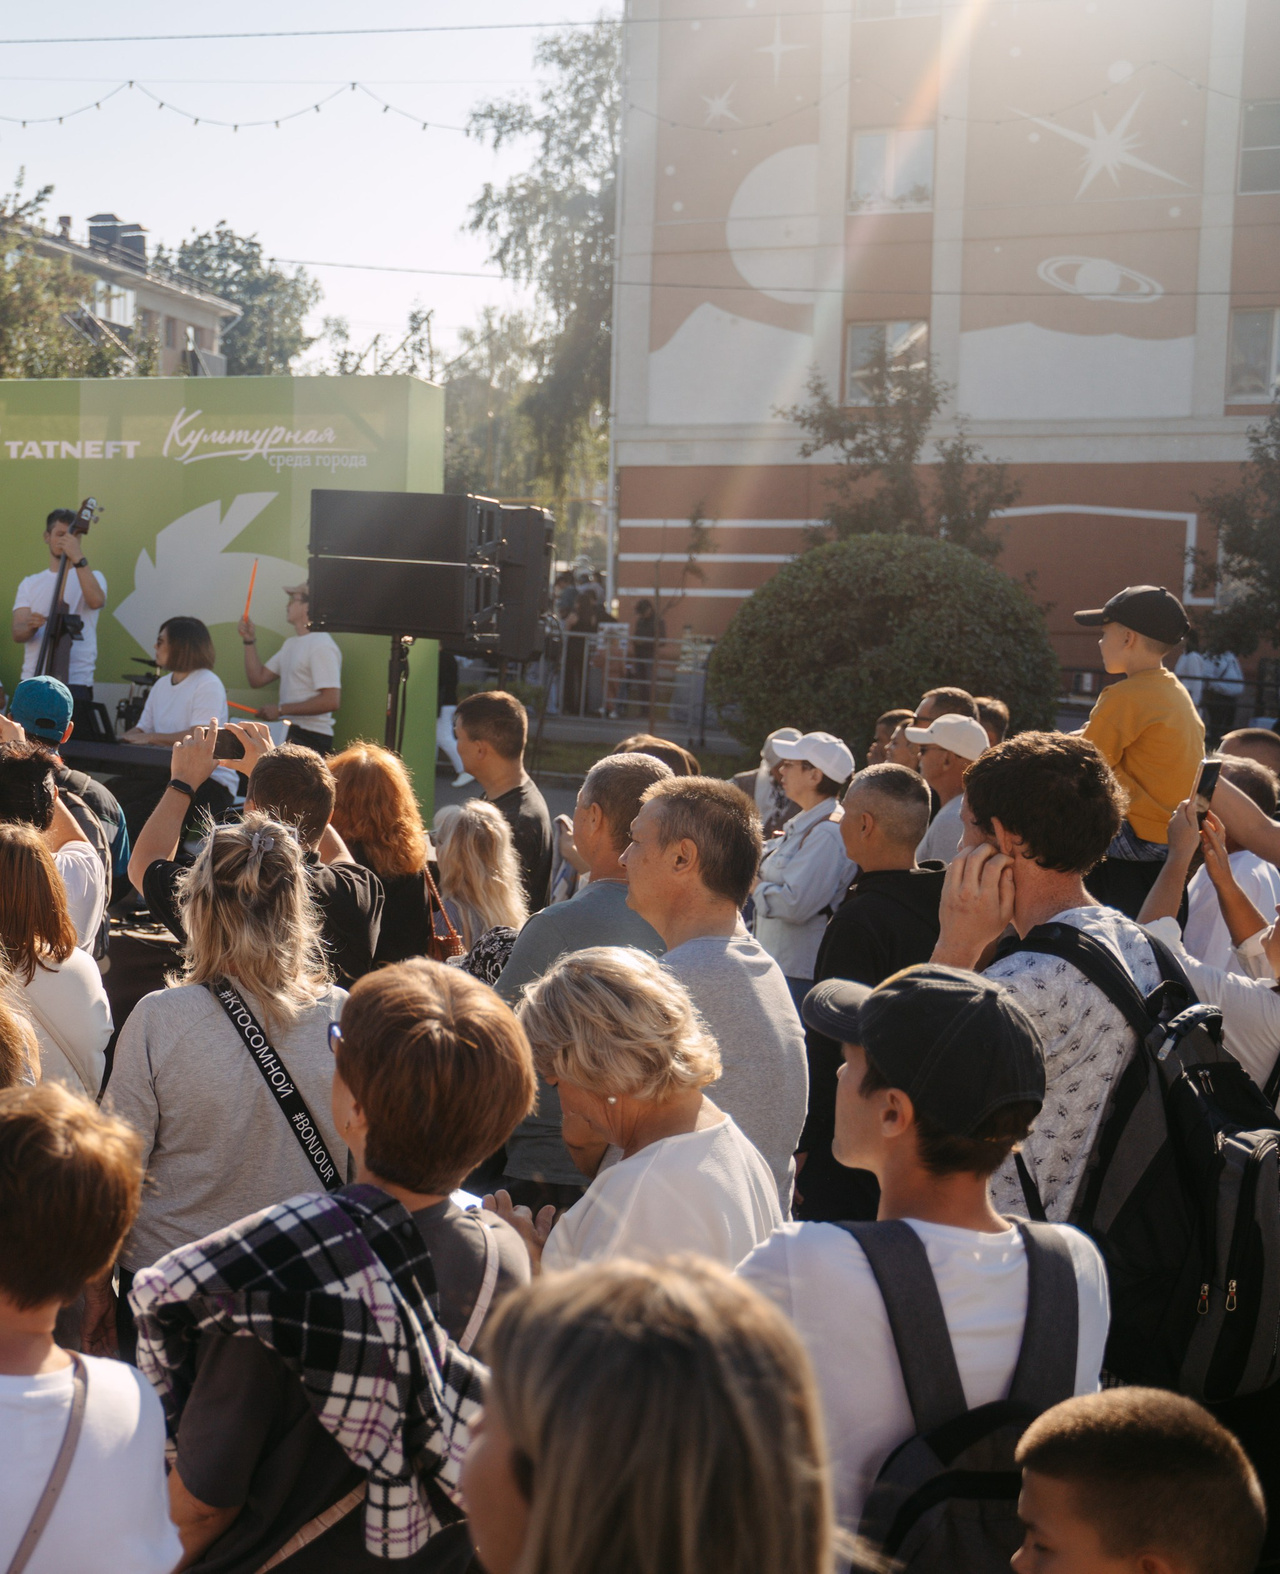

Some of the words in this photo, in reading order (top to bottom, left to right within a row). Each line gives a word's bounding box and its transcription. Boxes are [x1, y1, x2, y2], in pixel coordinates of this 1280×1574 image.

[4, 440, 141, 460] TATNEFT
[162, 407, 337, 462] Культурная
[269, 454, 311, 473] среда
[316, 454, 368, 473] города
[219, 990, 294, 1099] #КТОСОМНОЙ
[292, 1112, 335, 1182] #BONJOUR
